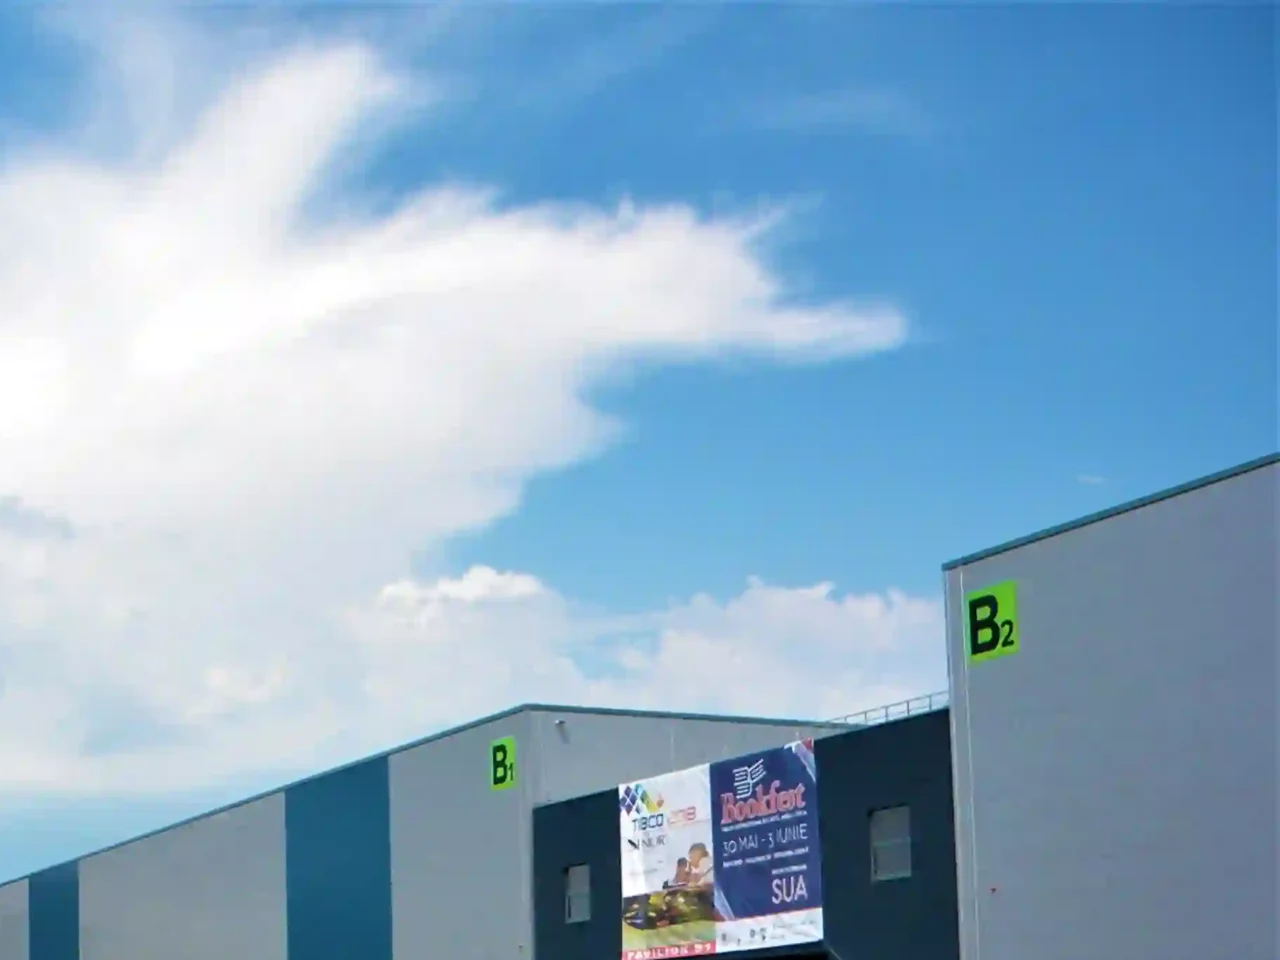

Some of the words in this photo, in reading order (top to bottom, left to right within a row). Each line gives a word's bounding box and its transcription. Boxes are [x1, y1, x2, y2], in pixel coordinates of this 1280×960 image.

[968, 594, 1015, 655] B2
[492, 744, 514, 785] B1
[721, 780, 807, 825] Bookfest
[723, 839, 738, 857] 30
[738, 833, 759, 851] MAI
[776, 823, 809, 844] IUNIE
[771, 874, 809, 904] SUA
